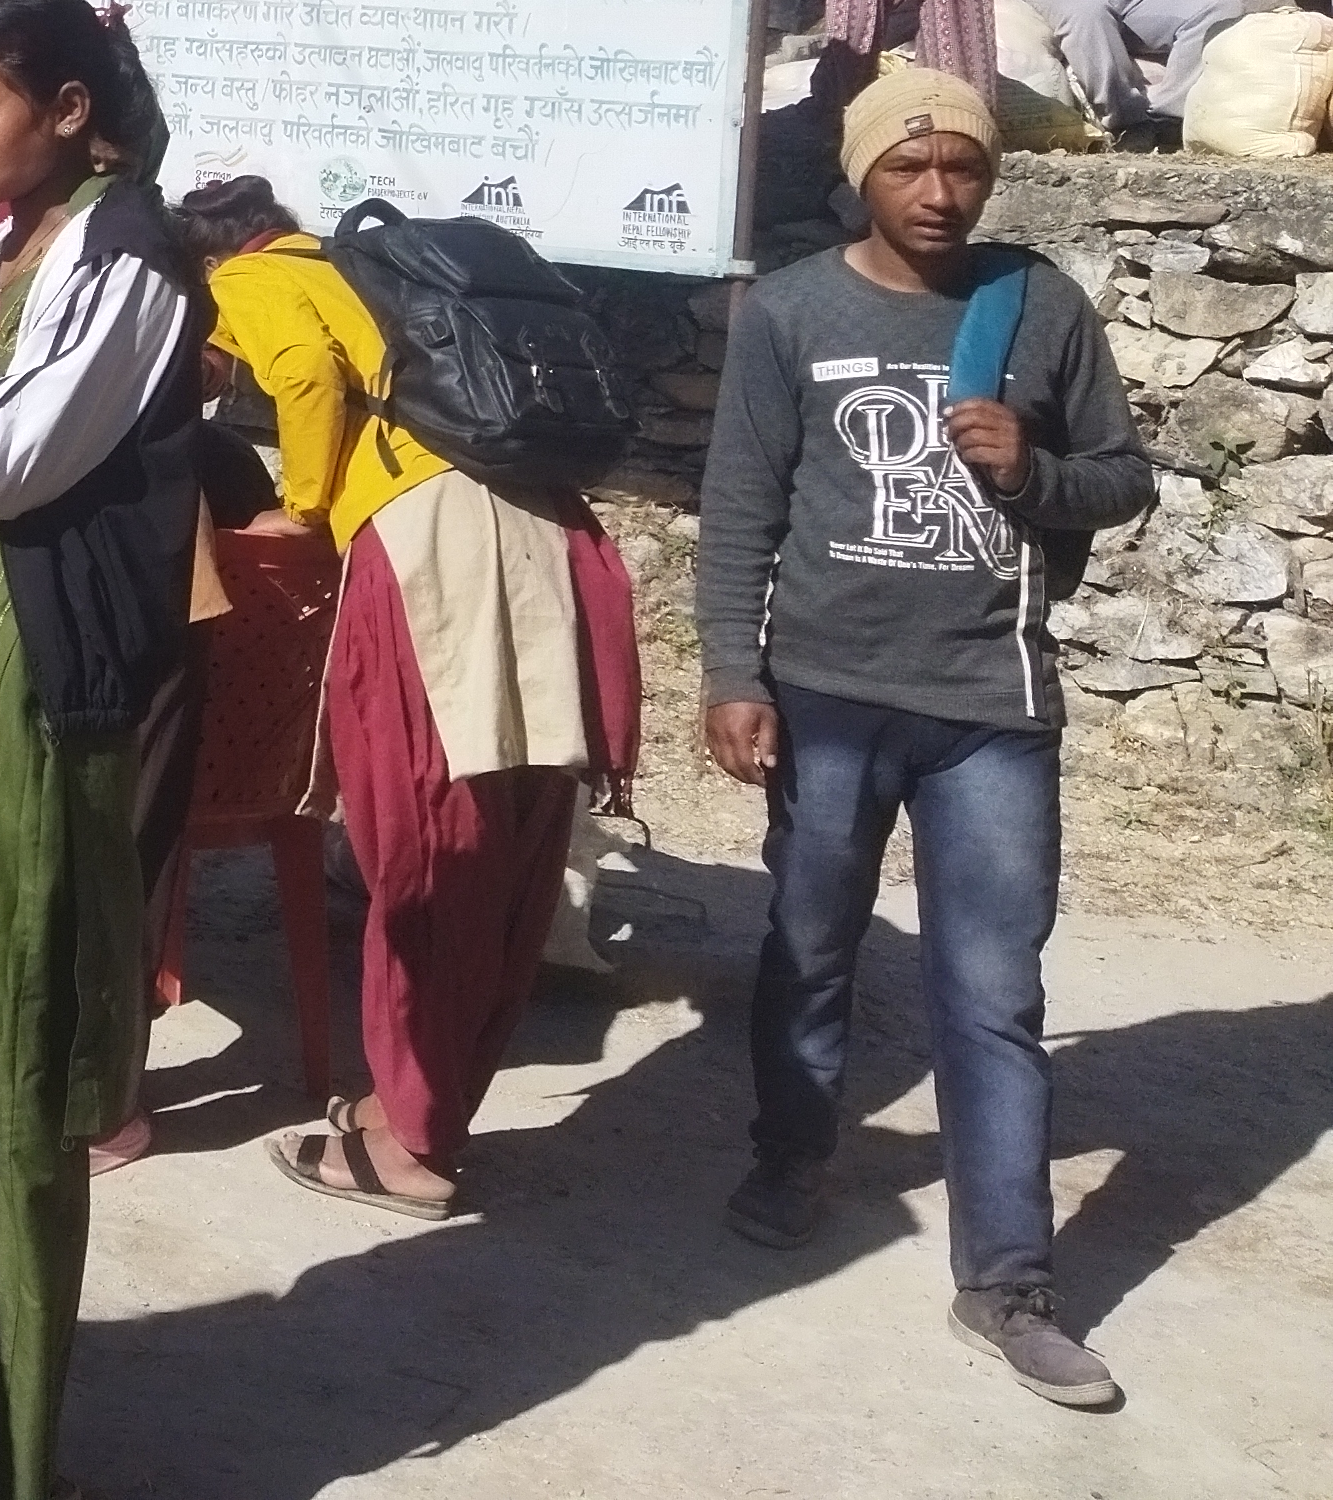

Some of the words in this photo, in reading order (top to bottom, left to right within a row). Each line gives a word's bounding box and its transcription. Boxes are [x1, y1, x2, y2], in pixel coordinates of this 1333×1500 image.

[360, 4, 469, 35] व्यवस्थापन
[423, 48, 485, 82] जलवायु
[486, 42, 585, 82] परिवर्तनको
[169, 73, 218, 99] जन्य
[426, 82, 478, 123] हरित
[482, 93, 518, 128] गृह
[199, 113, 275, 145] जलवायु
[281, 112, 373, 149] परिवर्तनको
[369, 175, 396, 186] TECH
[622, 211, 690, 226] INTERNATIONAL
[622, 223, 643, 235] NEPAL
[817, 362, 874, 377] THINGS
